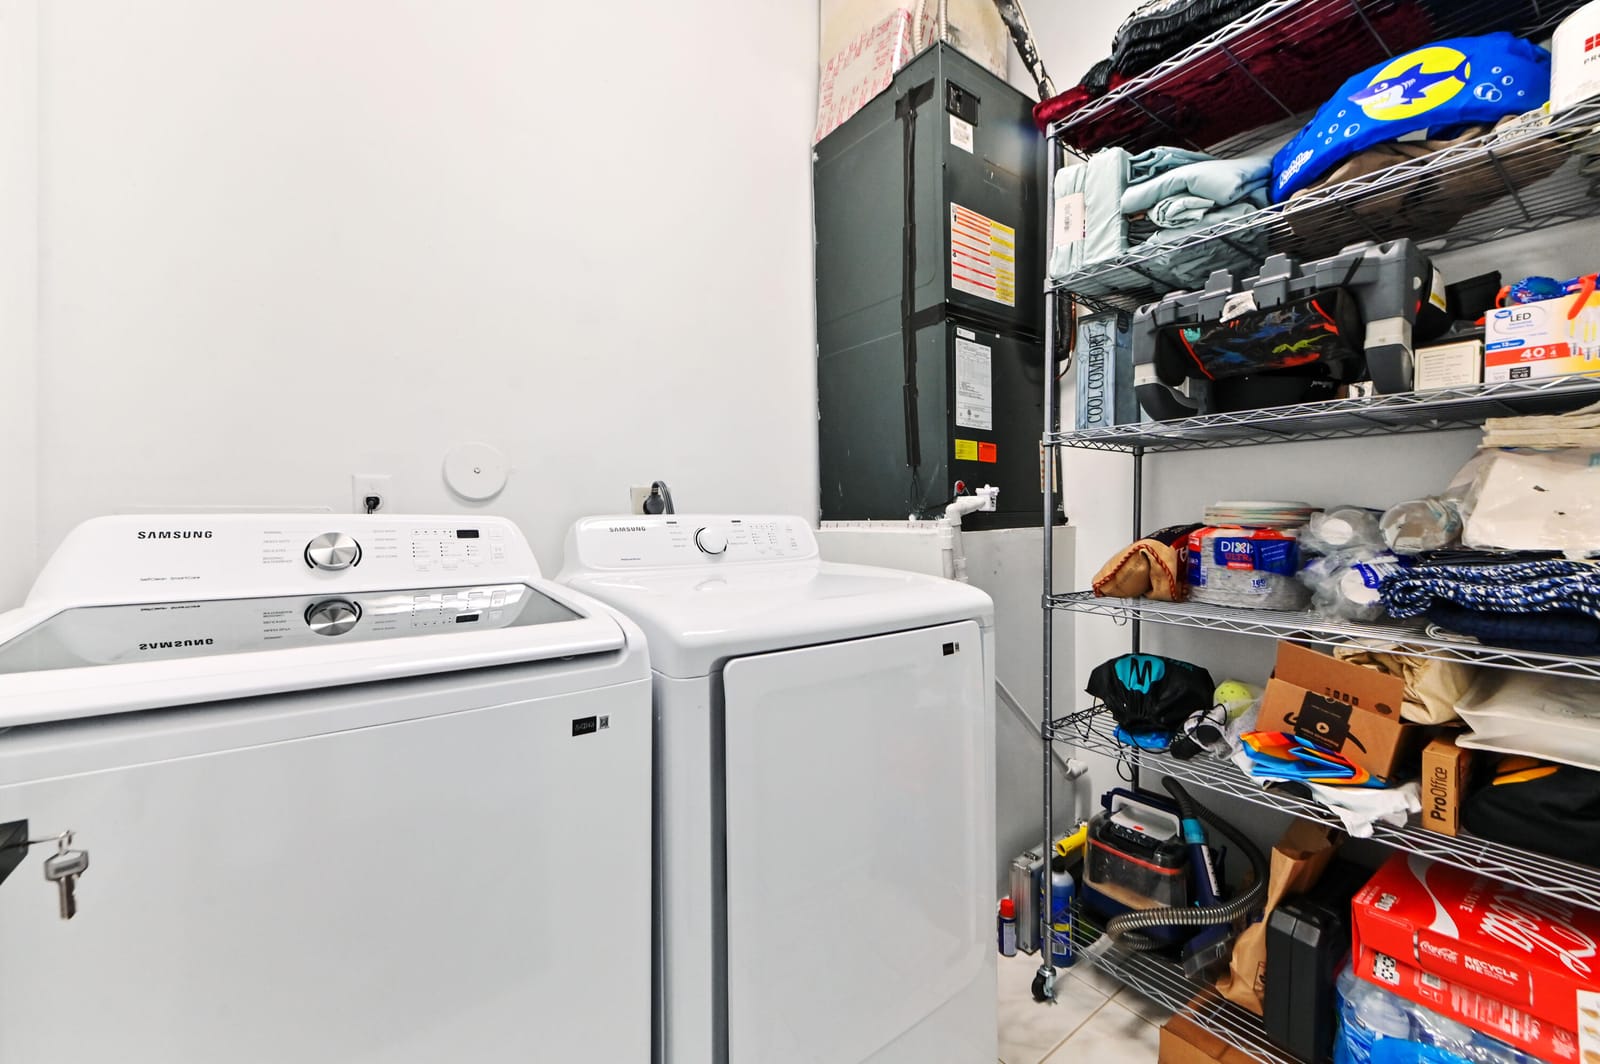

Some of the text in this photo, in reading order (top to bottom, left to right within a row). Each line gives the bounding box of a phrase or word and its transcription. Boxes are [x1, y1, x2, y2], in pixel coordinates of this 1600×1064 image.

[1510, 312, 1531, 322] LED
[1521, 347, 1545, 358] 40
[1087, 334, 1105, 423] COOL COMFORT
[137, 531, 213, 540] SAMSUNG
[1430, 766, 1448, 822] ProOffice
[1464, 955, 1519, 981] RECYCLE
